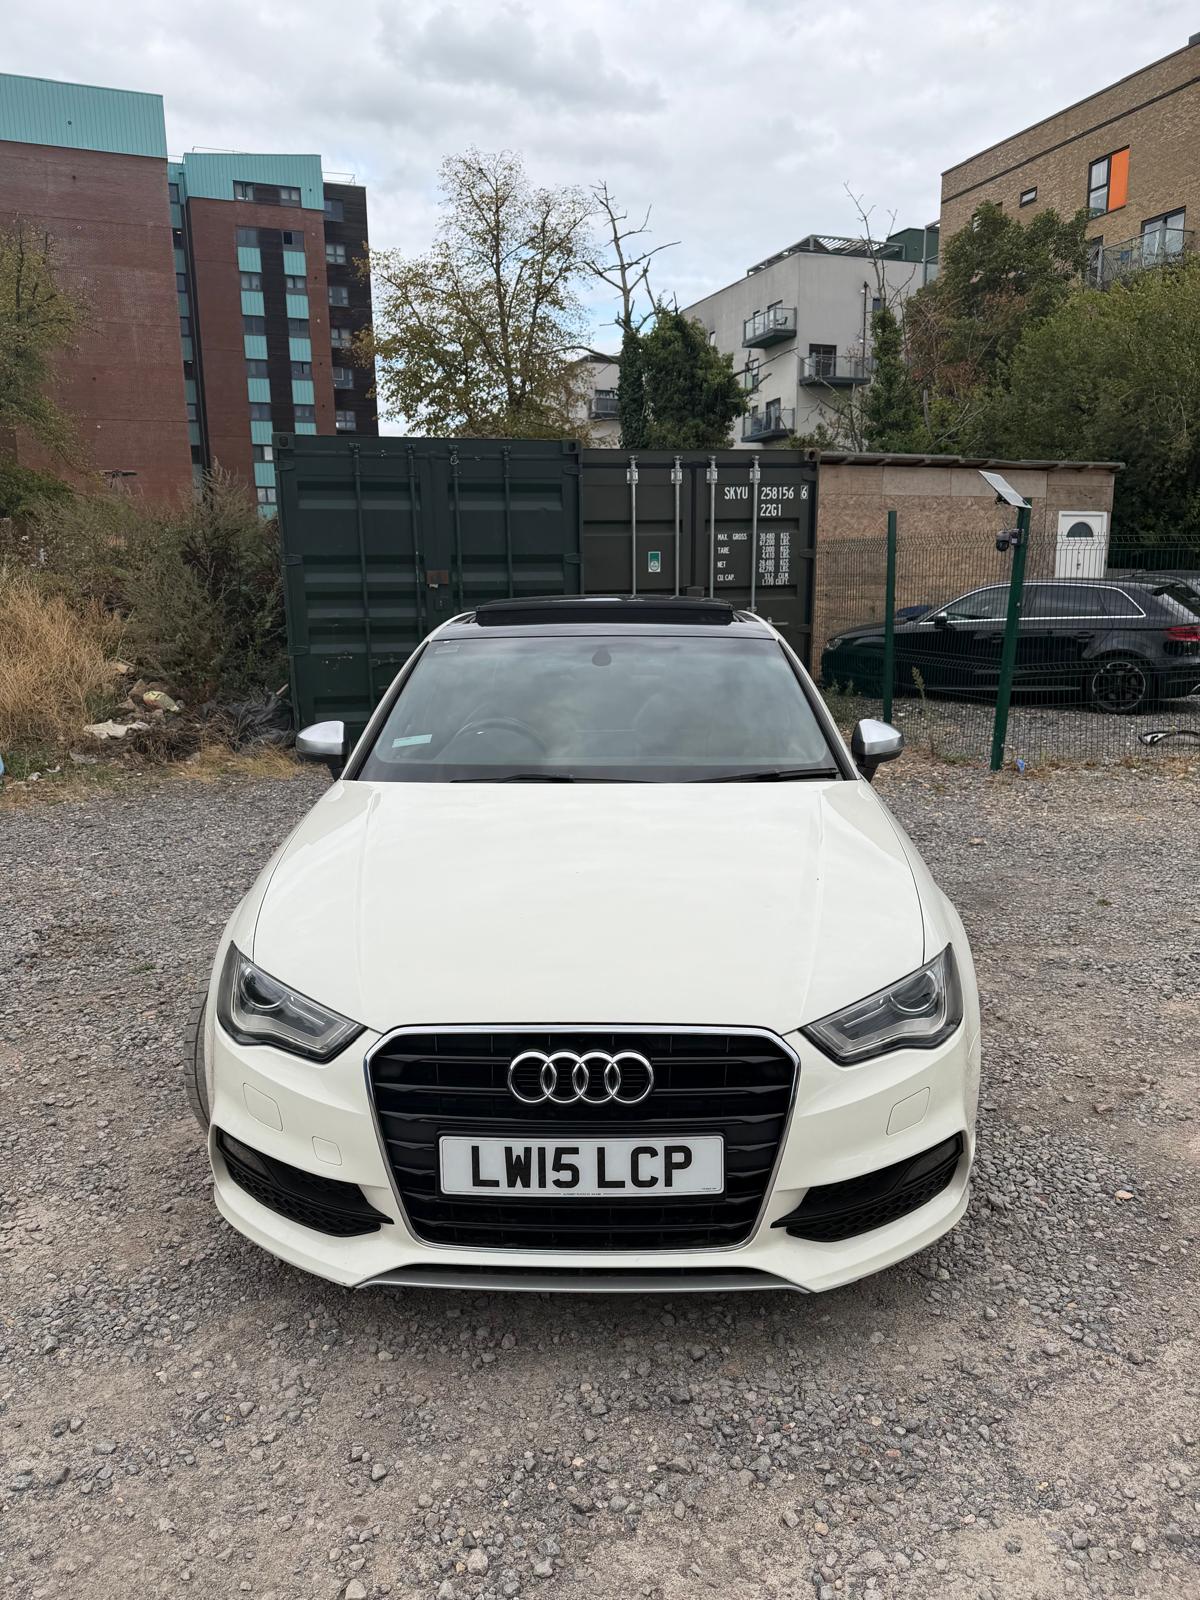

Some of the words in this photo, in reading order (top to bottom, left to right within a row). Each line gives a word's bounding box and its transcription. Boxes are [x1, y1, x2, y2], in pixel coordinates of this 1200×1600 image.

[724, 487, 749, 500] SKYU
[761, 487, 794, 500] 258156
[801, 486, 808, 499] 6
[760, 504, 782, 517] 22G1
[717, 546, 730, 554] TARE
[471, 1145, 580, 1189] LW15
[597, 1145, 693, 1188] LCP
